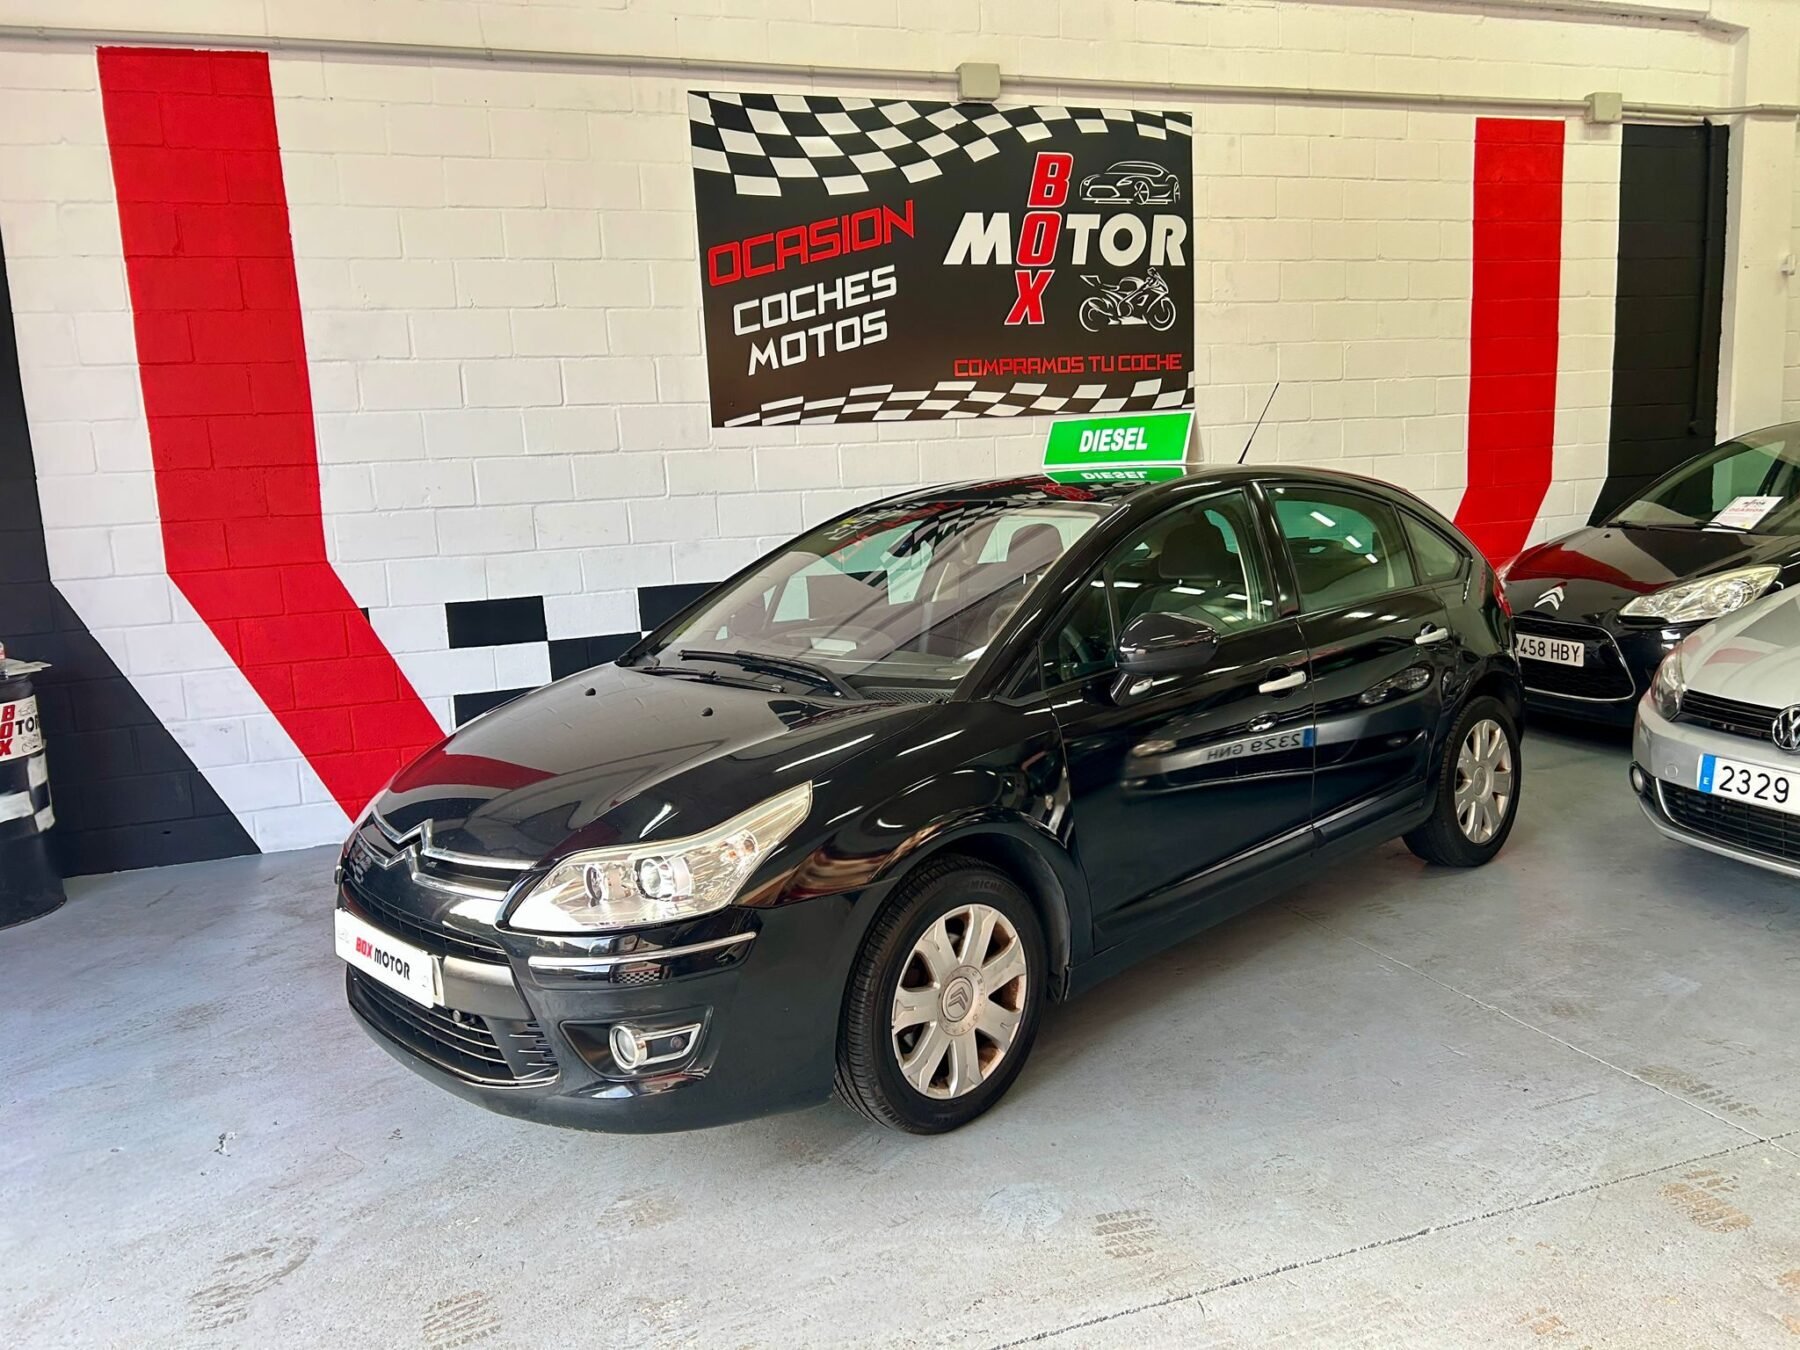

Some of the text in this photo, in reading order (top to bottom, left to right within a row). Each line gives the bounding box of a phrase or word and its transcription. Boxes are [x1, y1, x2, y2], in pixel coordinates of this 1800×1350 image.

[707, 199, 915, 287] OCASION
[1003, 151, 1074, 326] BOX
[733, 264, 897, 336] COCHES
[748, 308, 888, 376] MOTOS
[954, 353, 1182, 377] COMPRAMOS TU COCHE
[1078, 427, 1148, 453] DIESEL
[1515, 637, 1580, 663] 458 HBY
[1719, 765, 1790, 804] 2329
[355, 936, 411, 981] BOX MOTOR
